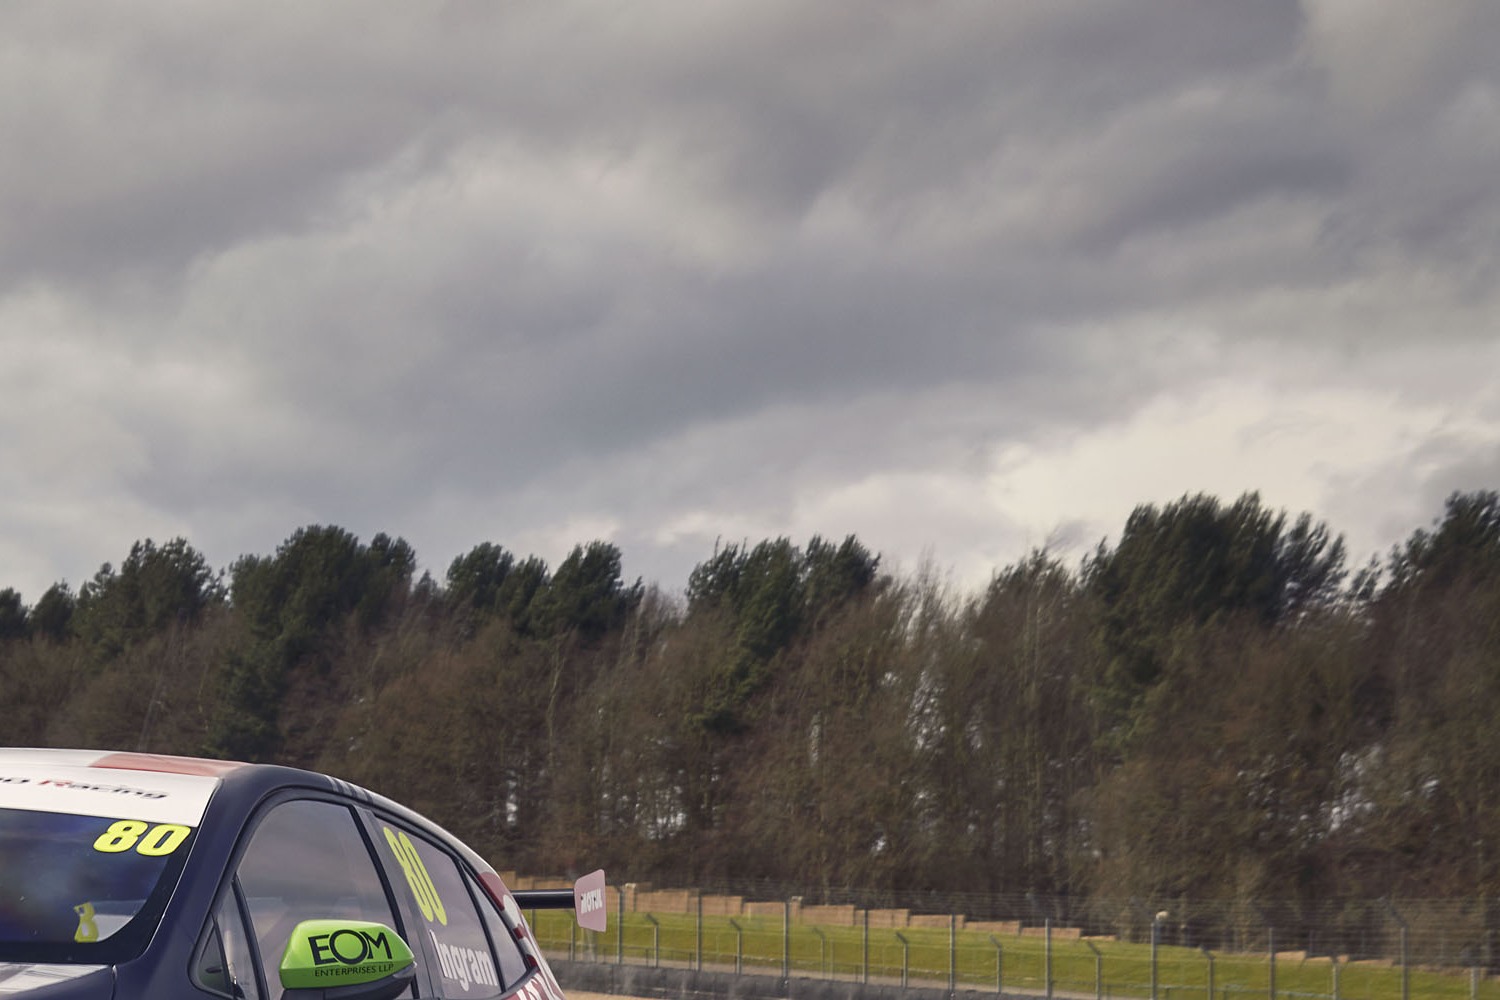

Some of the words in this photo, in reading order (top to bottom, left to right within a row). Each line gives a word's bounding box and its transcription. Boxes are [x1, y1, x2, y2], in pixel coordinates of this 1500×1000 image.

[93, 820, 191, 856] 80
[383, 826, 448, 926] 80
[308, 929, 393, 966] EOM
[429, 929, 499, 991] Ingram
[314, 965, 377, 977] ENTERPRISES
[378, 963, 394, 973] LLP
